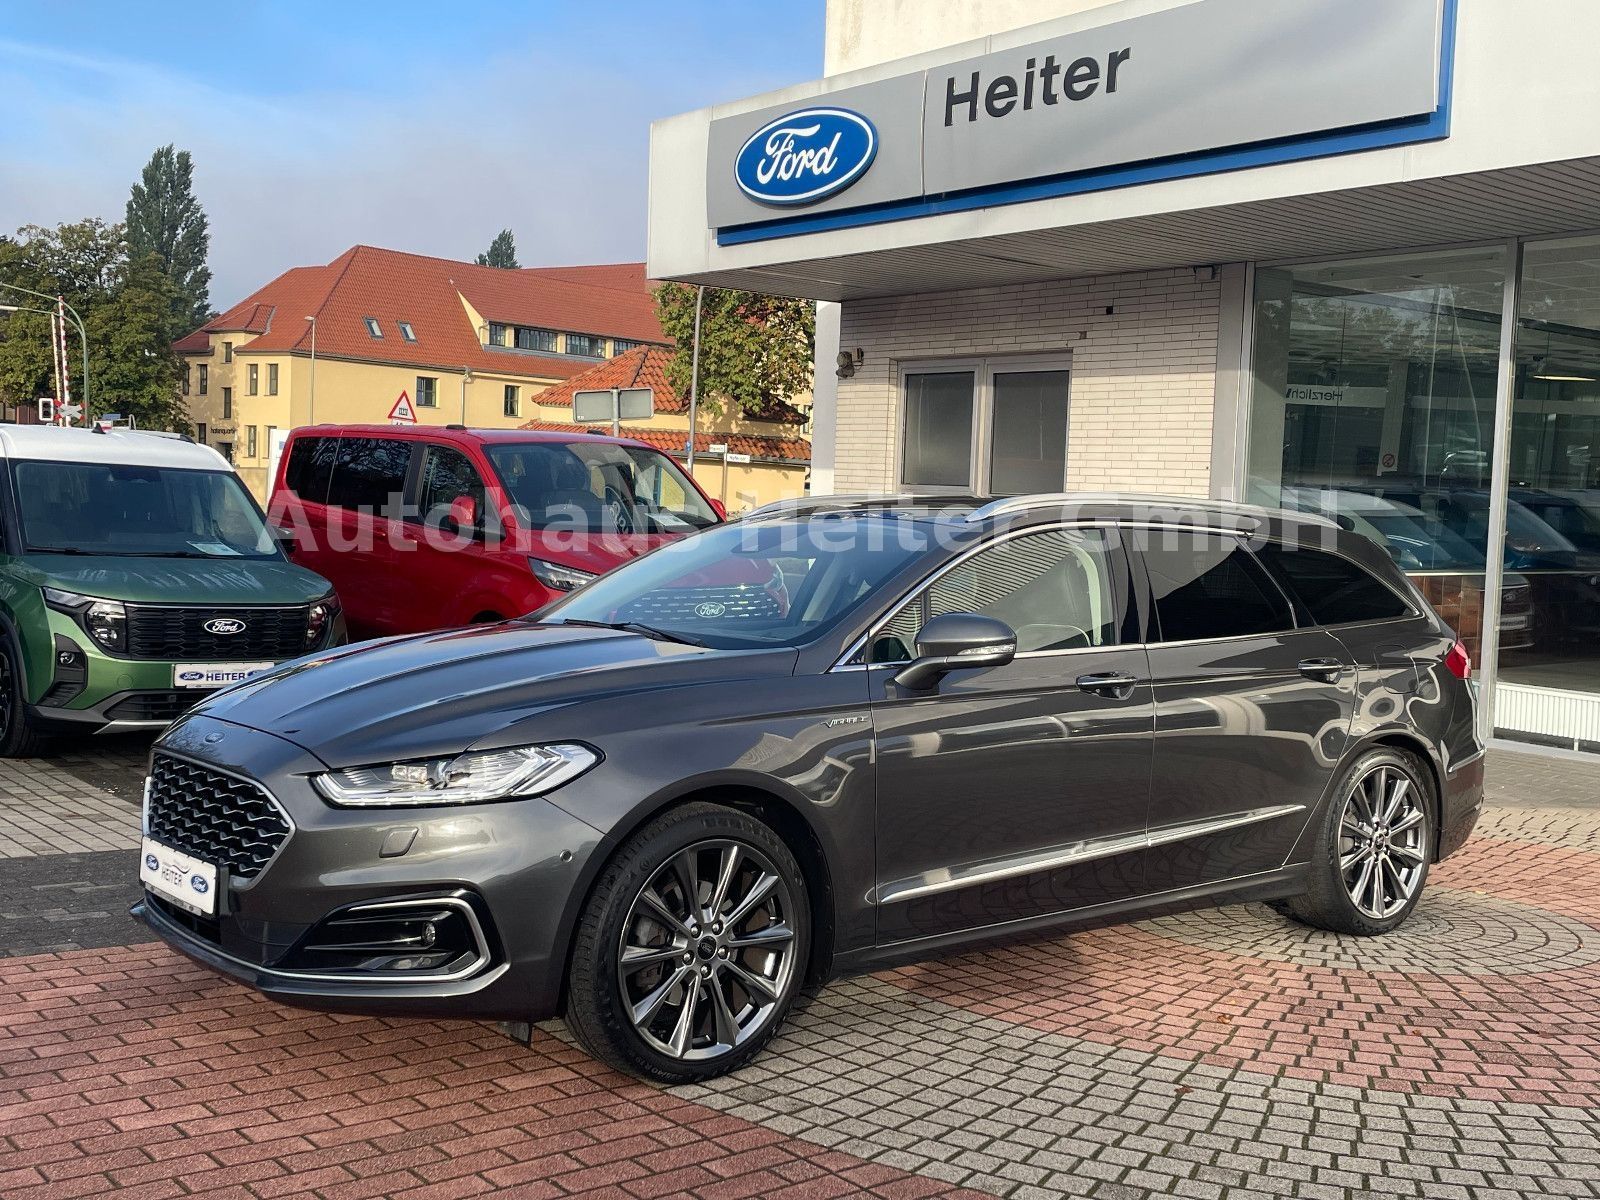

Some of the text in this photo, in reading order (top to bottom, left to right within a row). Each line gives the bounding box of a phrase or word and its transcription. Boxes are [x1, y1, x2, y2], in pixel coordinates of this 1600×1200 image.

[944, 47, 1130, 127] Heiter
[757, 123, 842, 185] Ford
[699, 603, 721, 616] Ford
[211, 620, 240, 632] Ford
[206, 672, 245, 681] HEITER
[162, 867, 183, 888] HEITER
